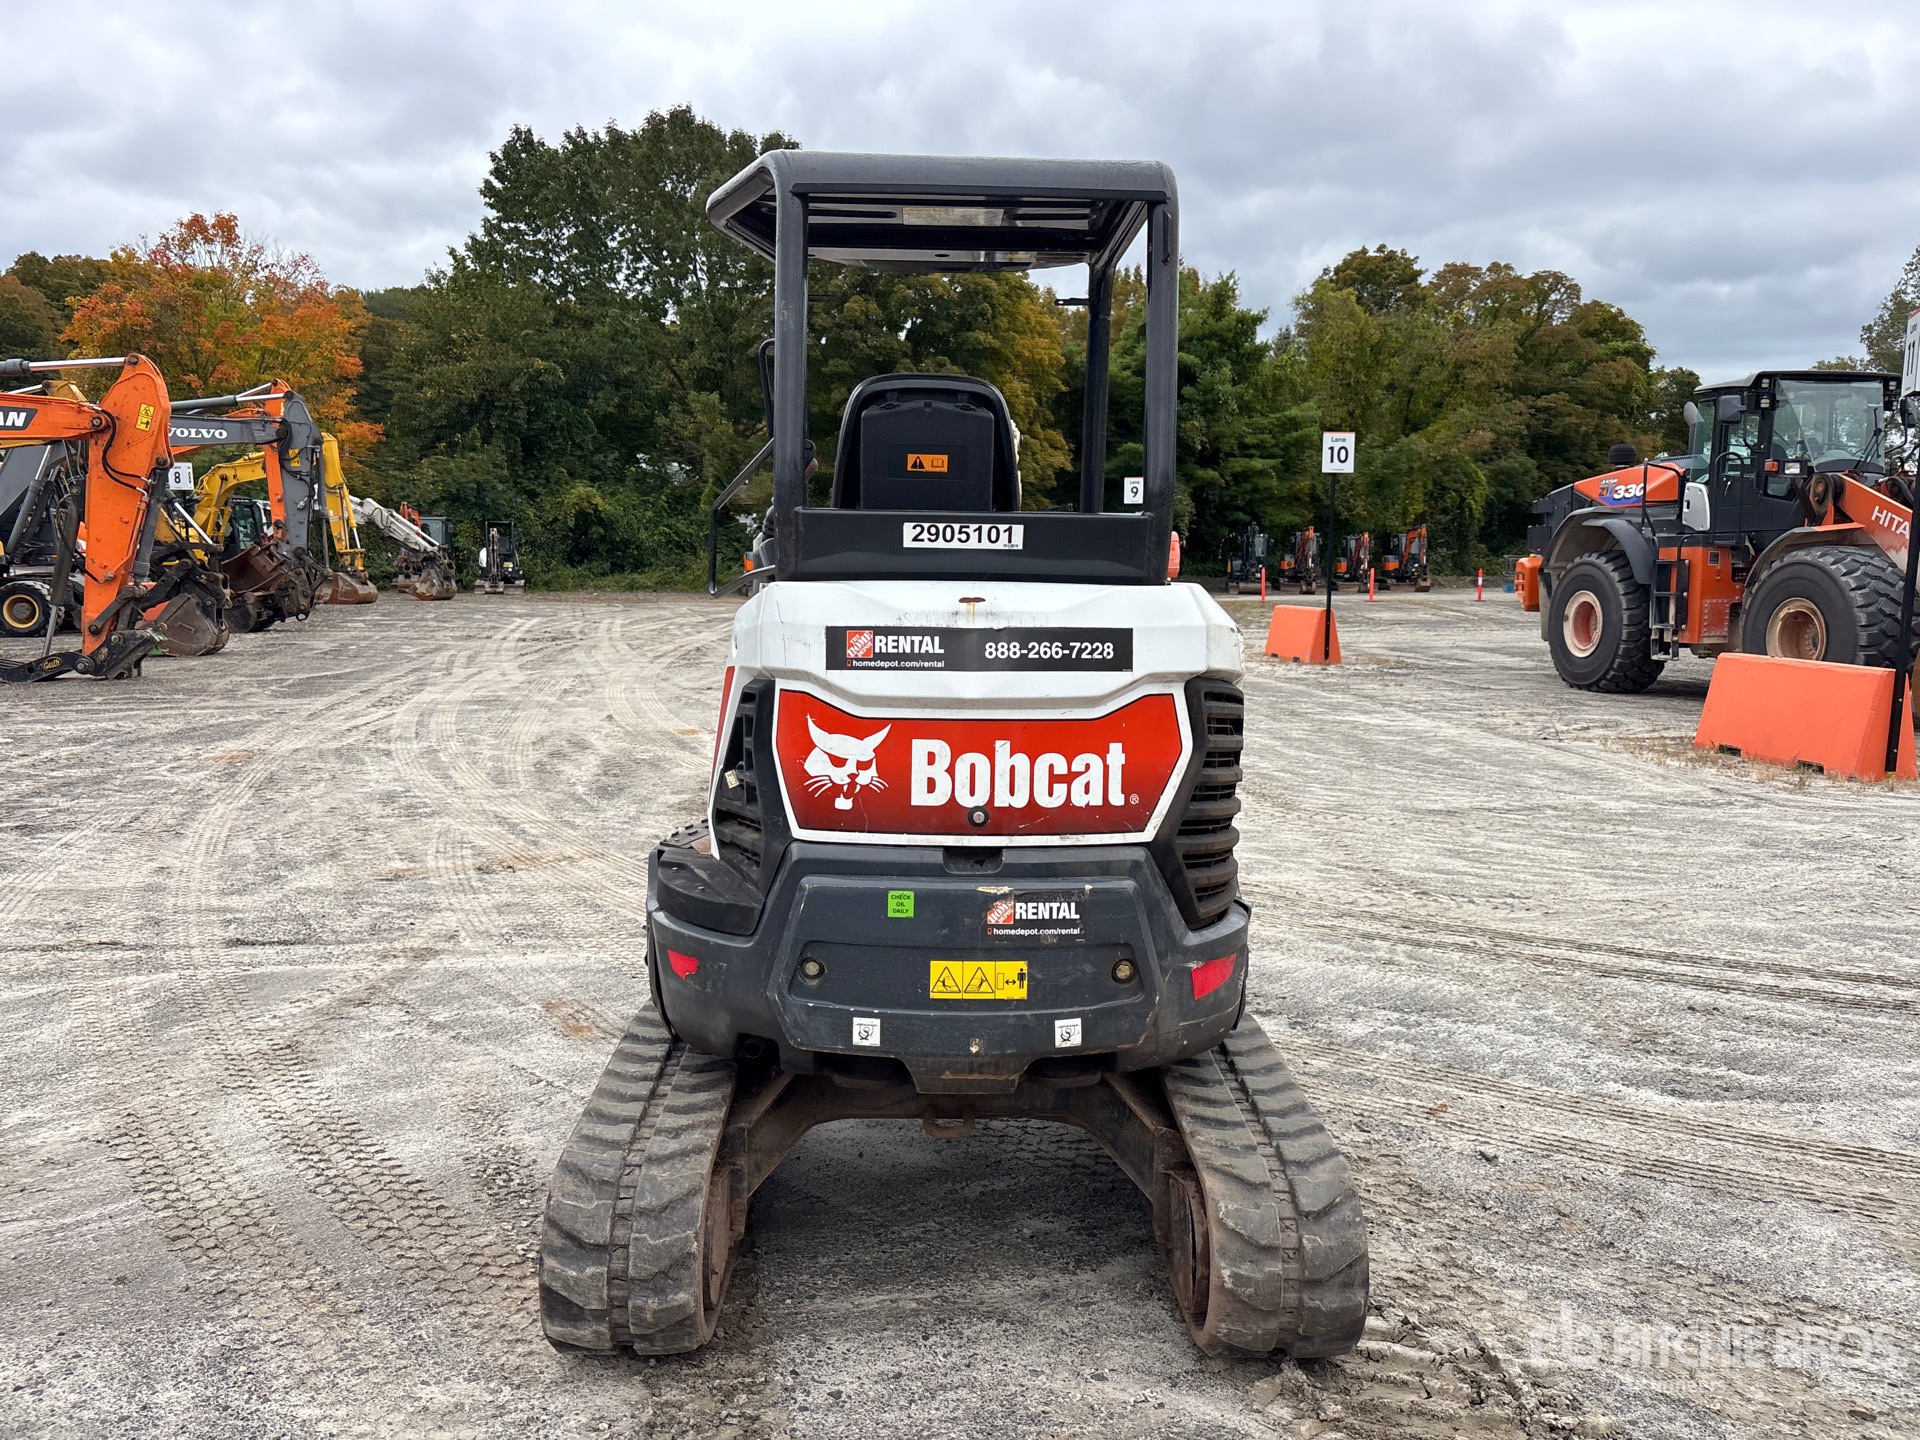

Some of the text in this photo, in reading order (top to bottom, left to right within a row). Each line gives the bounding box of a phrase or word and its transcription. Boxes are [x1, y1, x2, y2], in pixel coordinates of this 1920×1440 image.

[1328, 446, 1349, 464] 10
[174, 471, 181, 484] 8
[1130, 486, 1139, 498] 9
[911, 524, 1014, 544] 2905101
[874, 635, 945, 654] RENTAL
[984, 641, 1115, 659] 888-266-7228
[852, 660, 945, 668] homedepot.com/rental
[911, 738, 1126, 809] Bobcat
[1015, 902, 1080, 919] RENTAL
[993, 928, 1080, 936] homedepot.com/rental
